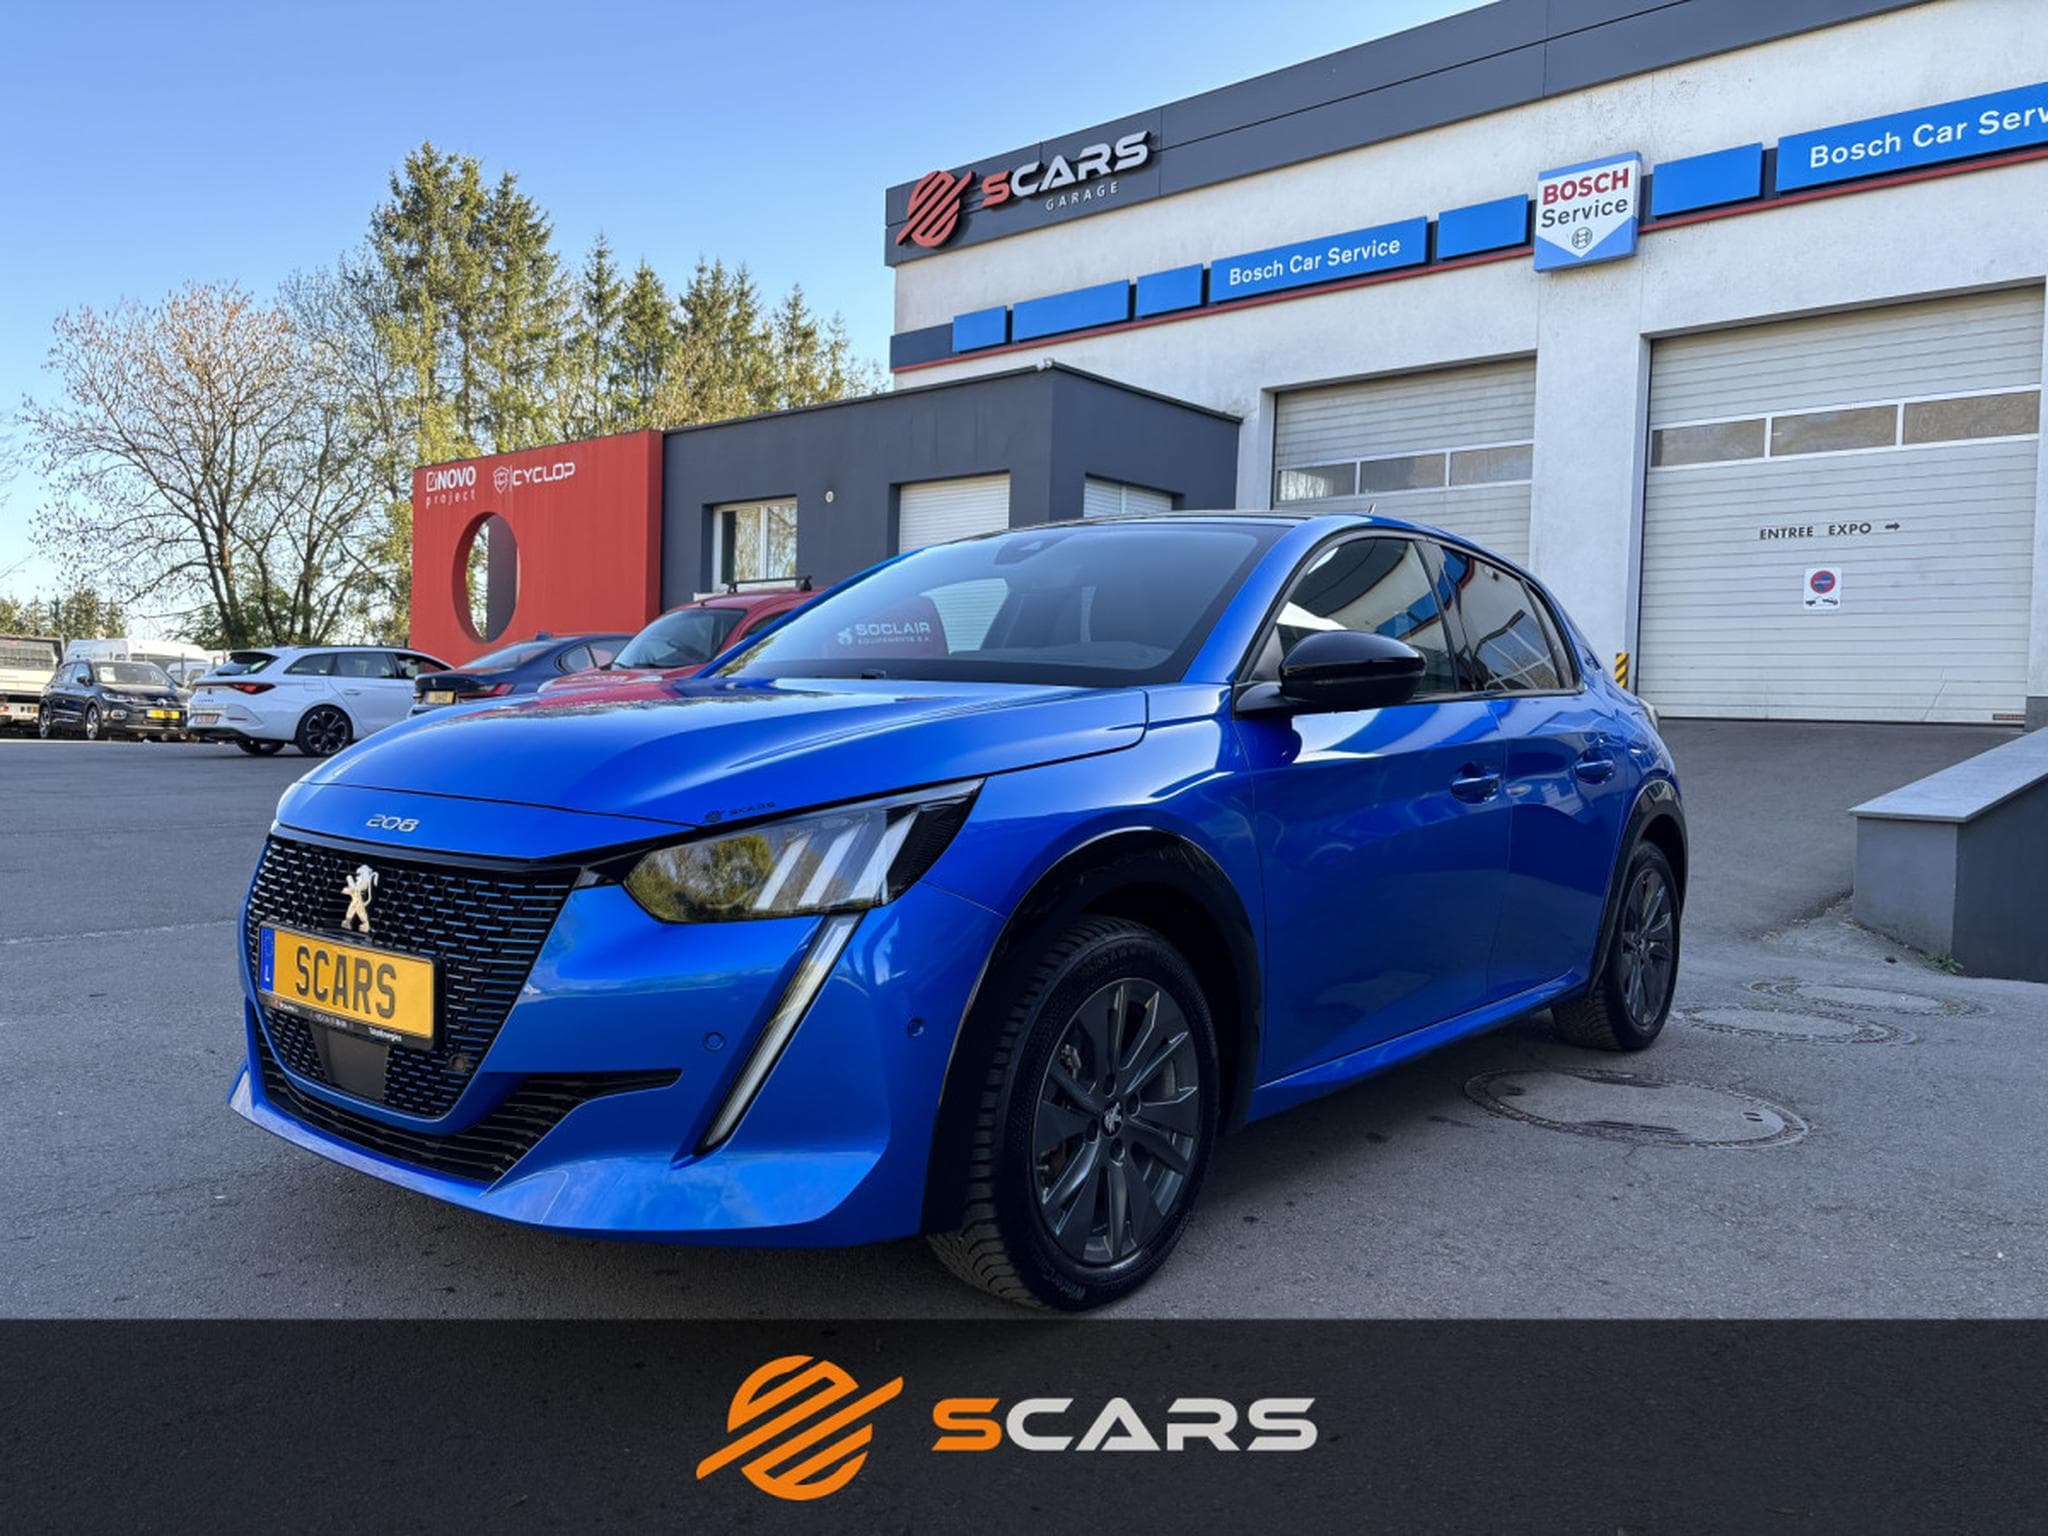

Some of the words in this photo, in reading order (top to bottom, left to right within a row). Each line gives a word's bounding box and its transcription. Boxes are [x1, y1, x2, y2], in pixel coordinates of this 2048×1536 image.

[1809, 131, 1901, 169] Bosch
[1912, 120, 1968, 149] Car
[1977, 106, 2048, 136] Serv
[981, 130, 1150, 208] SCARS
[1045, 182, 1120, 212] GARAGE
[1542, 167, 1629, 206] BOSCH
[1541, 199, 1628, 228] Service
[1229, 259, 1284, 286] Bosch
[1289, 254, 1322, 273] Car
[1327, 239, 1401, 267] Service
[512, 461, 577, 486] CYCLOP
[425, 489, 476, 510] project
[1759, 526, 1814, 540] ENTREE
[1828, 522, 1872, 536] EXPO
[854, 621, 931, 636] SOCLAIR
[365, 813, 421, 832] 208
[295, 943, 397, 1020] SCARS
